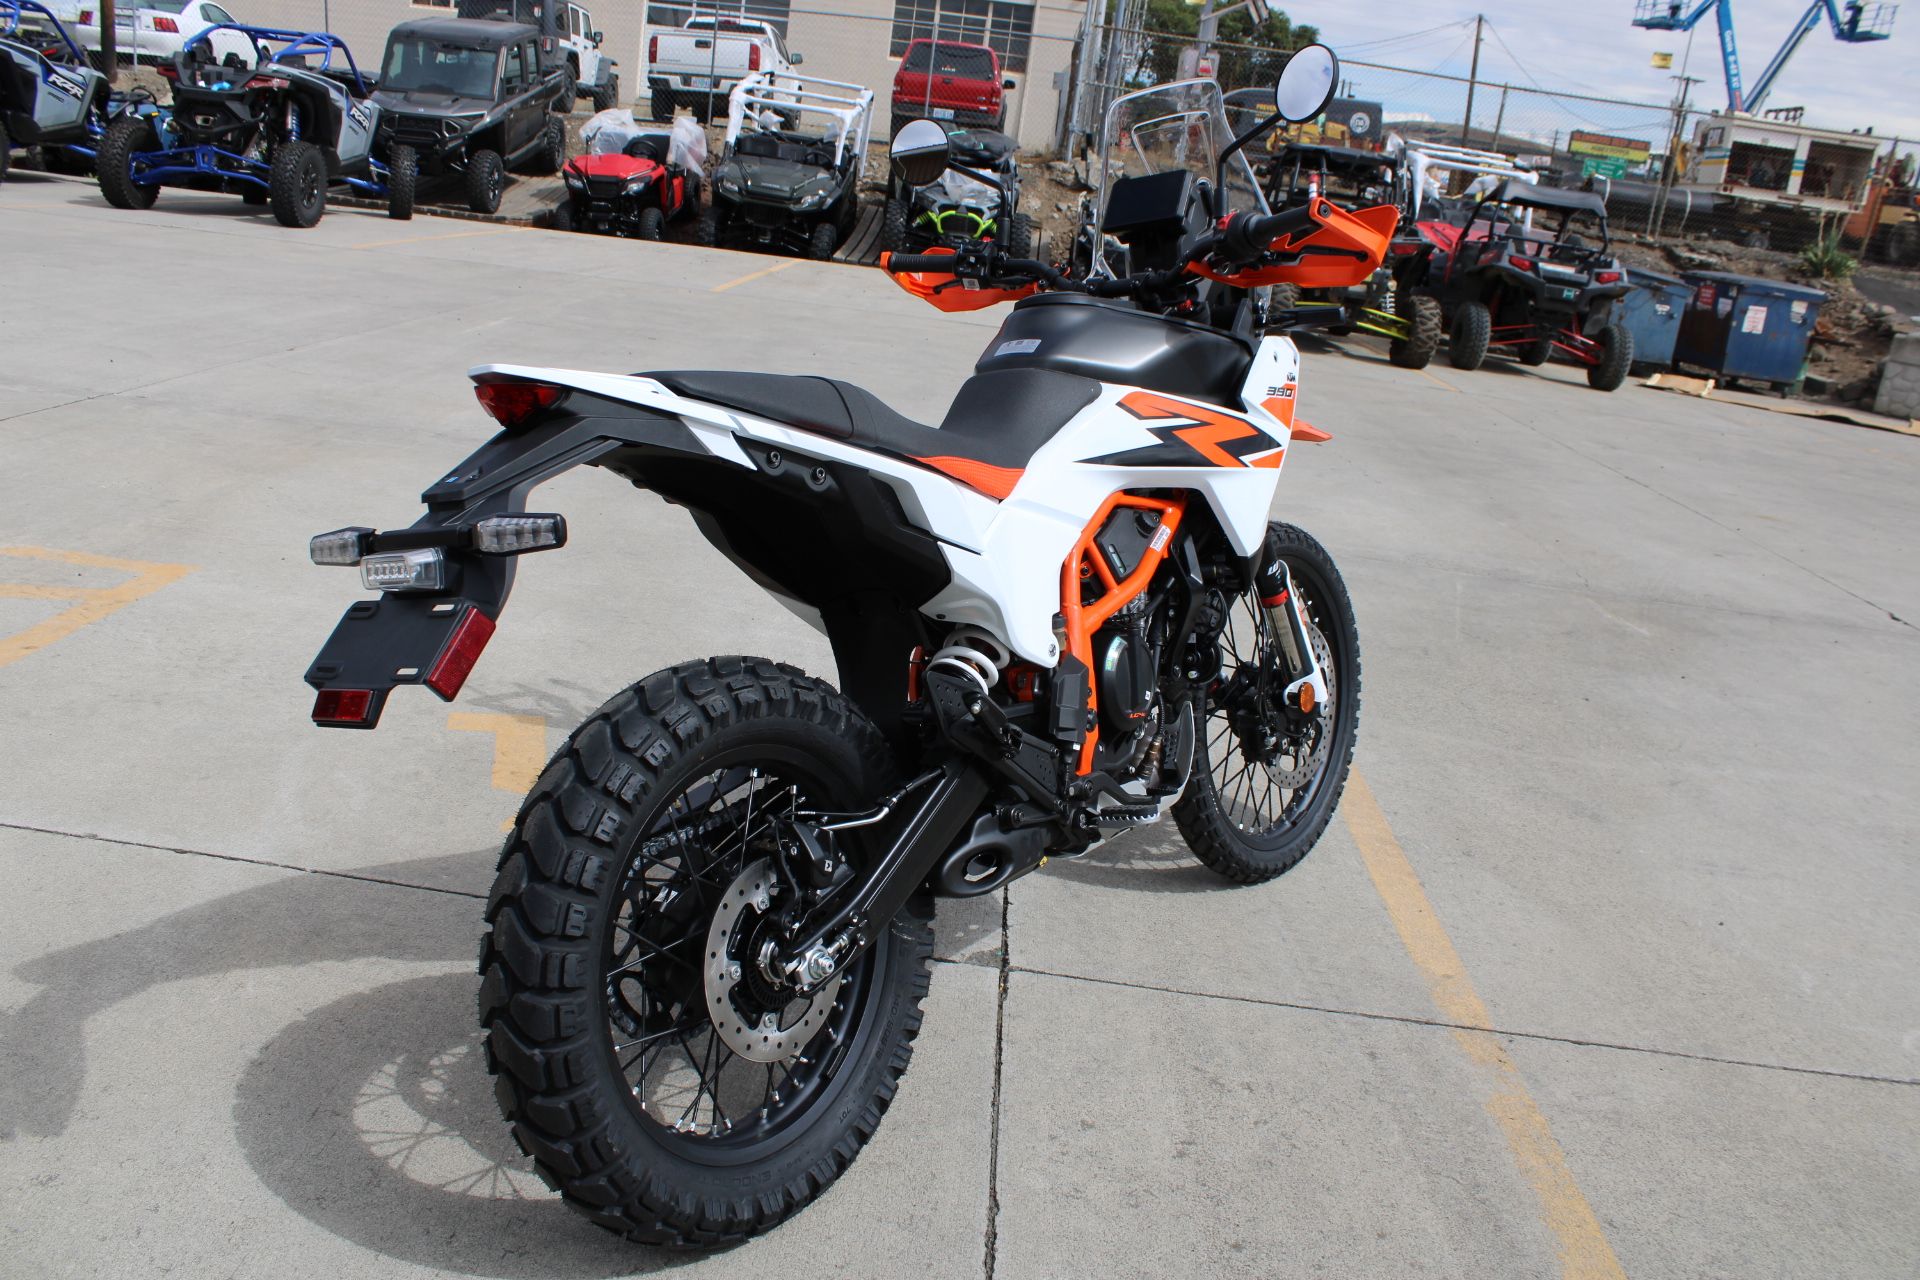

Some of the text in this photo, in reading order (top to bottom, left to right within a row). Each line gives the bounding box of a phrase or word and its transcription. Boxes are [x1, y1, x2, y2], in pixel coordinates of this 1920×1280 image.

[48, 73, 84, 99] RZR
[1286, 372, 1296, 382] KTM
[1266, 386, 1294, 398] 390
